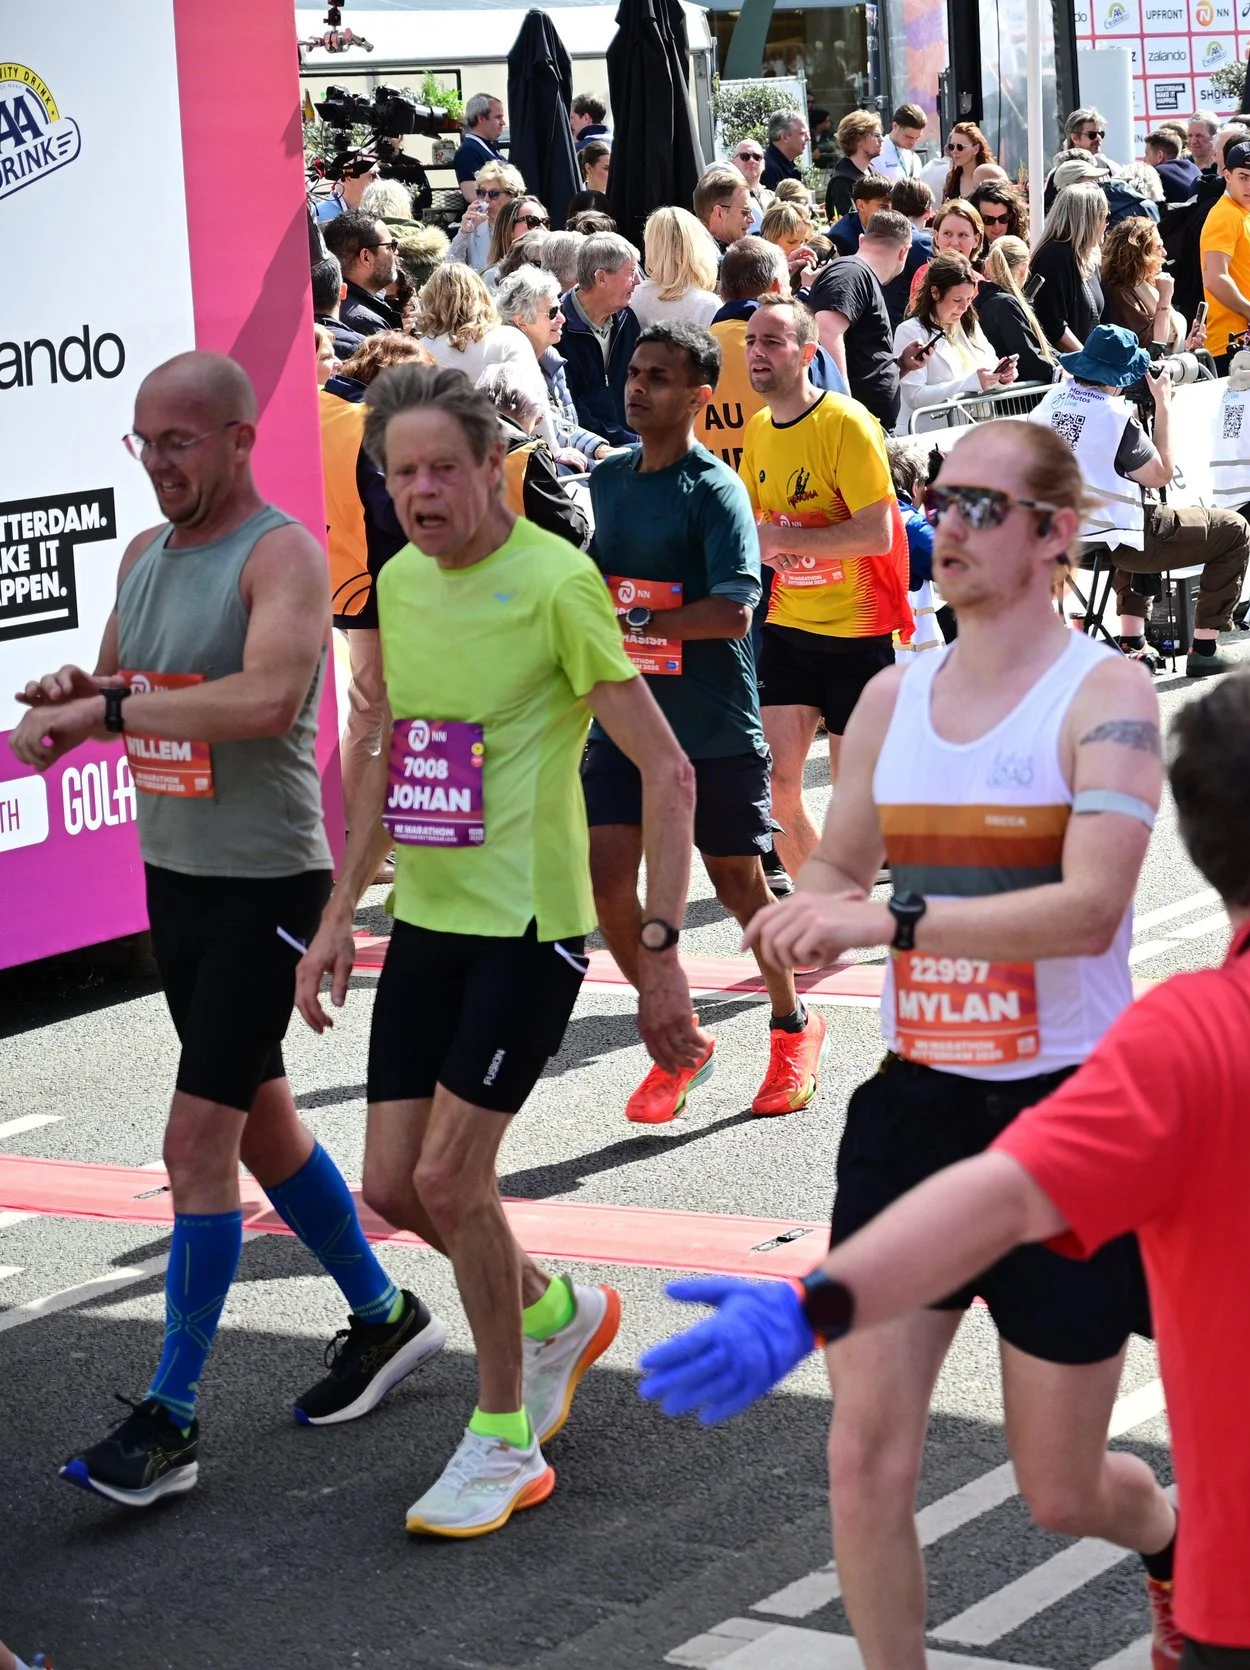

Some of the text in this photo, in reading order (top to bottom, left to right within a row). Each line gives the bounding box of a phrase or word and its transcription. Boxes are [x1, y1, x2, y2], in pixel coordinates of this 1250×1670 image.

[1145, 9, 1183, 20] UPFRONT
[1217, 8, 1229, 17] NN
[1148, 50, 1186, 62] zalando
[23, 71, 52, 105] DRINK
[0, 136, 58, 187] RINK
[0, 324, 125, 390] ando
[1067, 393, 1090, 403] Photos
[1069, 387, 1105, 401] Marathon
[705, 402, 744, 430] AU
[0, 540, 60, 574] KE IT
[0, 571, 67, 606] PPEN.
[637, 590, 650, 598] NN
[125, 735, 192, 761] WILLEM
[431, 730, 447, 742] NN
[404, 756, 448, 780] 7008
[62, 755, 138, 836] GOLA
[388, 784, 471, 812] JOHAN
[404, 825, 455, 837] MARATHON
[910, 956, 990, 984] 22997
[899, 988, 1020, 1022] MYLAN
[482, 1048, 506, 1086] FUSION
